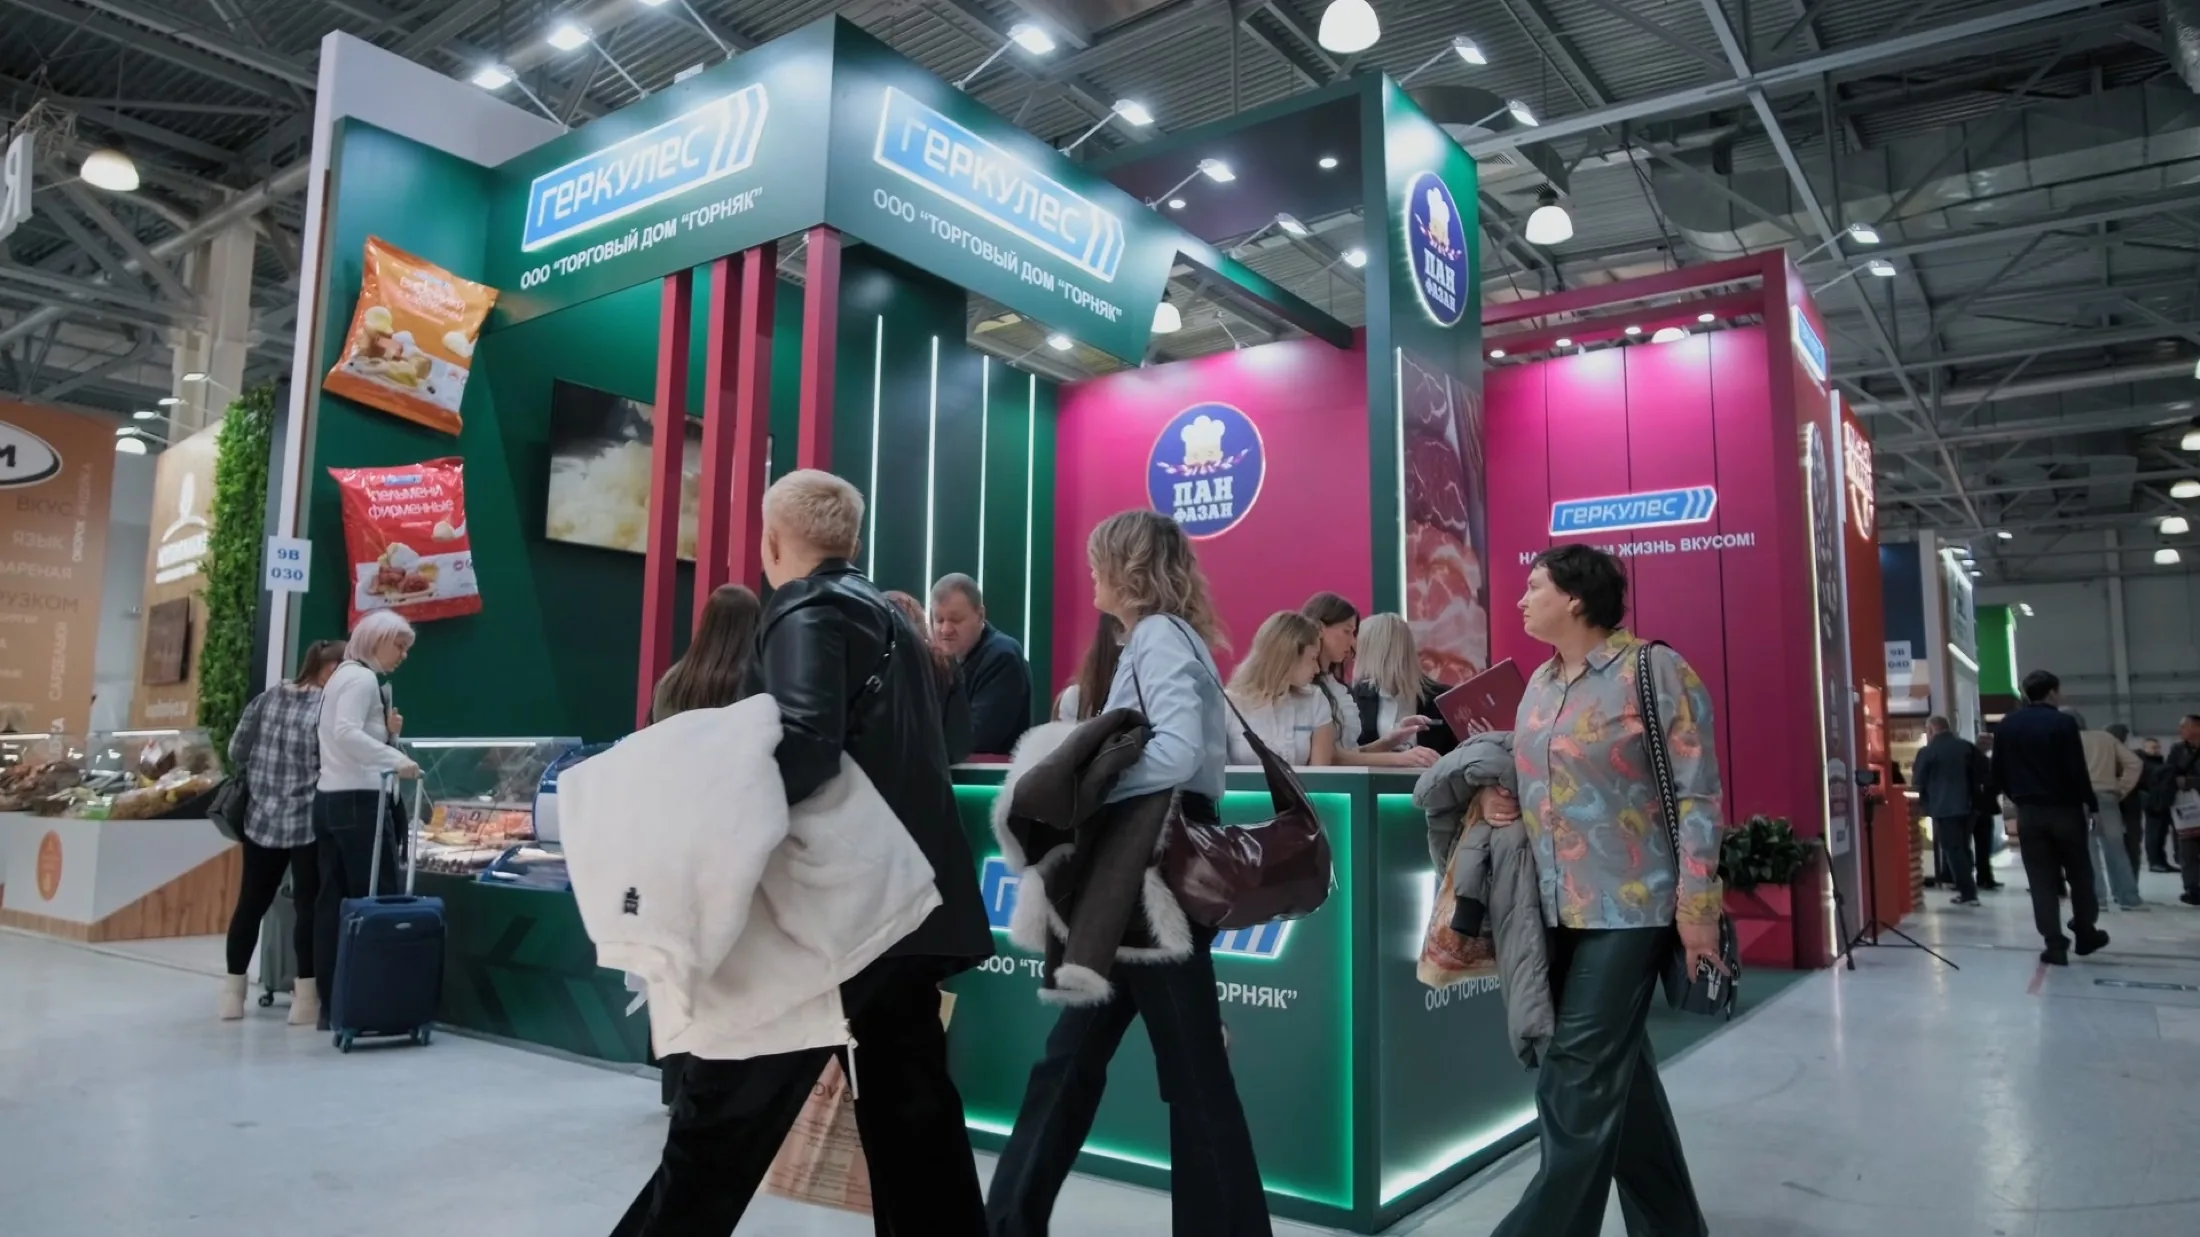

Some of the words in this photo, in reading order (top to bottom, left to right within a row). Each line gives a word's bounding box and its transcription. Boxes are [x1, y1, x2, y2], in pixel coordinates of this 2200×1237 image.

[520, 264, 551, 289] ООО
[640, 219, 677, 250] ДОМ
[873, 188, 915, 223] ООО
[1021, 260, 1055, 292] ДОМ
[1423, 246, 1456, 295] ПАН
[1424, 277, 1457, 313] ФАЗАН
[1173, 476, 1234, 507] ПАН
[1173, 502, 1233, 524] ФАЗАН
[1619, 540, 1676, 557] ЖИЗНЬ
[1680, 532, 1756, 552] ВКУСОМ!
[270, 568, 304, 582] 030
[1216, 981, 1298, 1009] ОРНЯК”
[1425, 986, 1450, 1011] ООО
